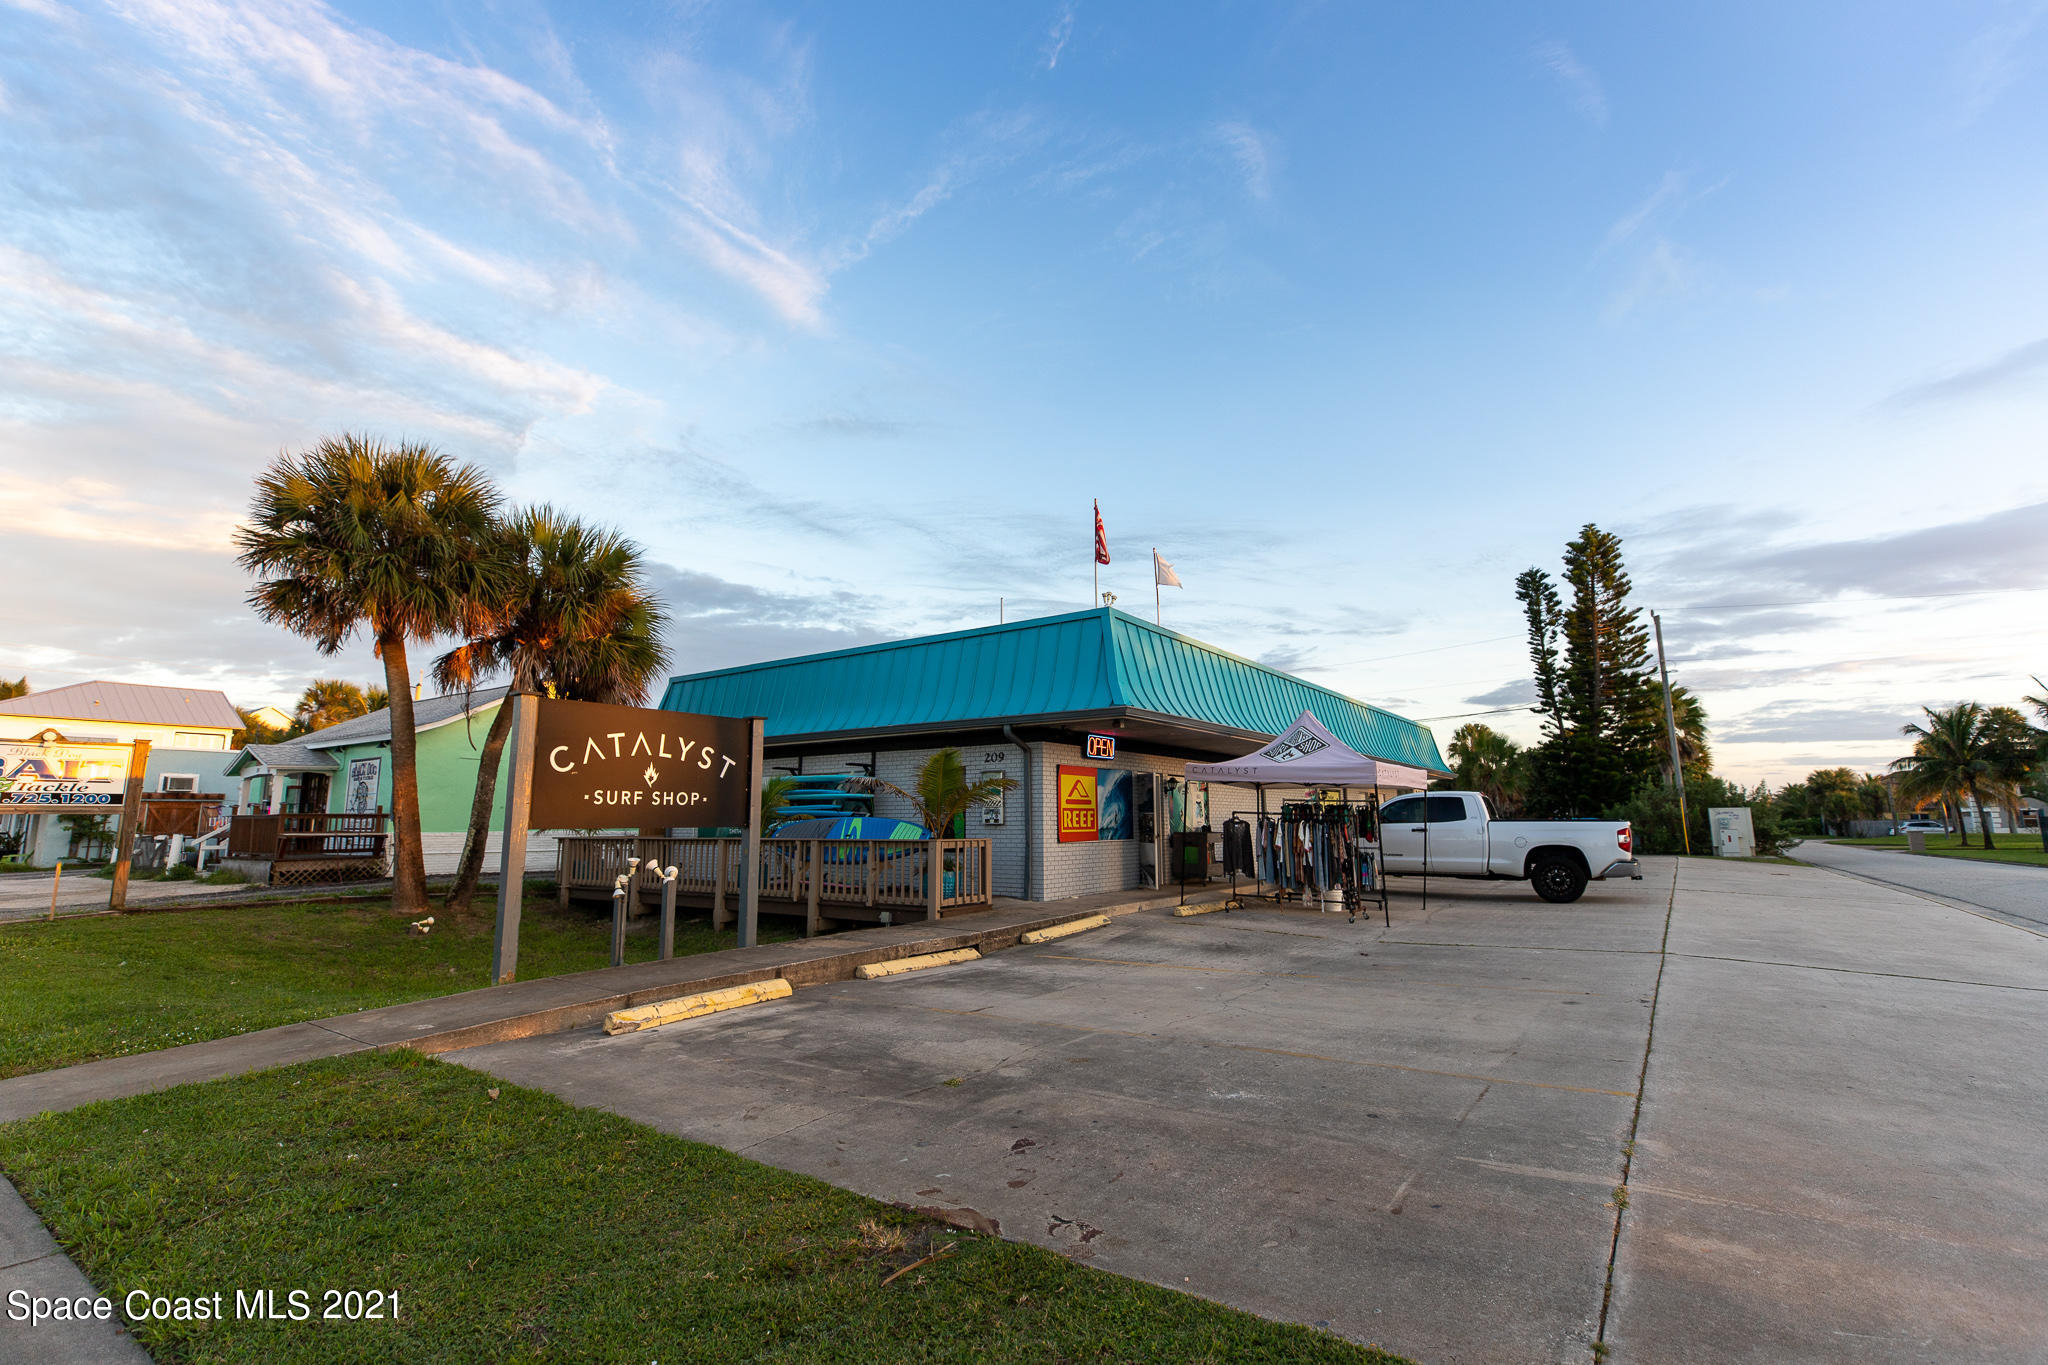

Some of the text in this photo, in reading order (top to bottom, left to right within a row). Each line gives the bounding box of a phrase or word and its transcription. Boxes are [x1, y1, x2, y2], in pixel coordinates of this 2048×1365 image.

[1088, 736, 1115, 758] OPEN
[1298, 739, 1322, 753] SHOP
[549, 731, 736, 779] CATALYST
[984, 752, 1005, 763] 209
[0, 757, 123, 783] AIT
[1192, 766, 1258, 775] CATALYST
[17, 782, 89, 792] Tackle
[0, 793, 111, 804] .725.1200
[593, 790, 700, 806] SURF SHOP
[1063, 810, 1095, 829] REEF
